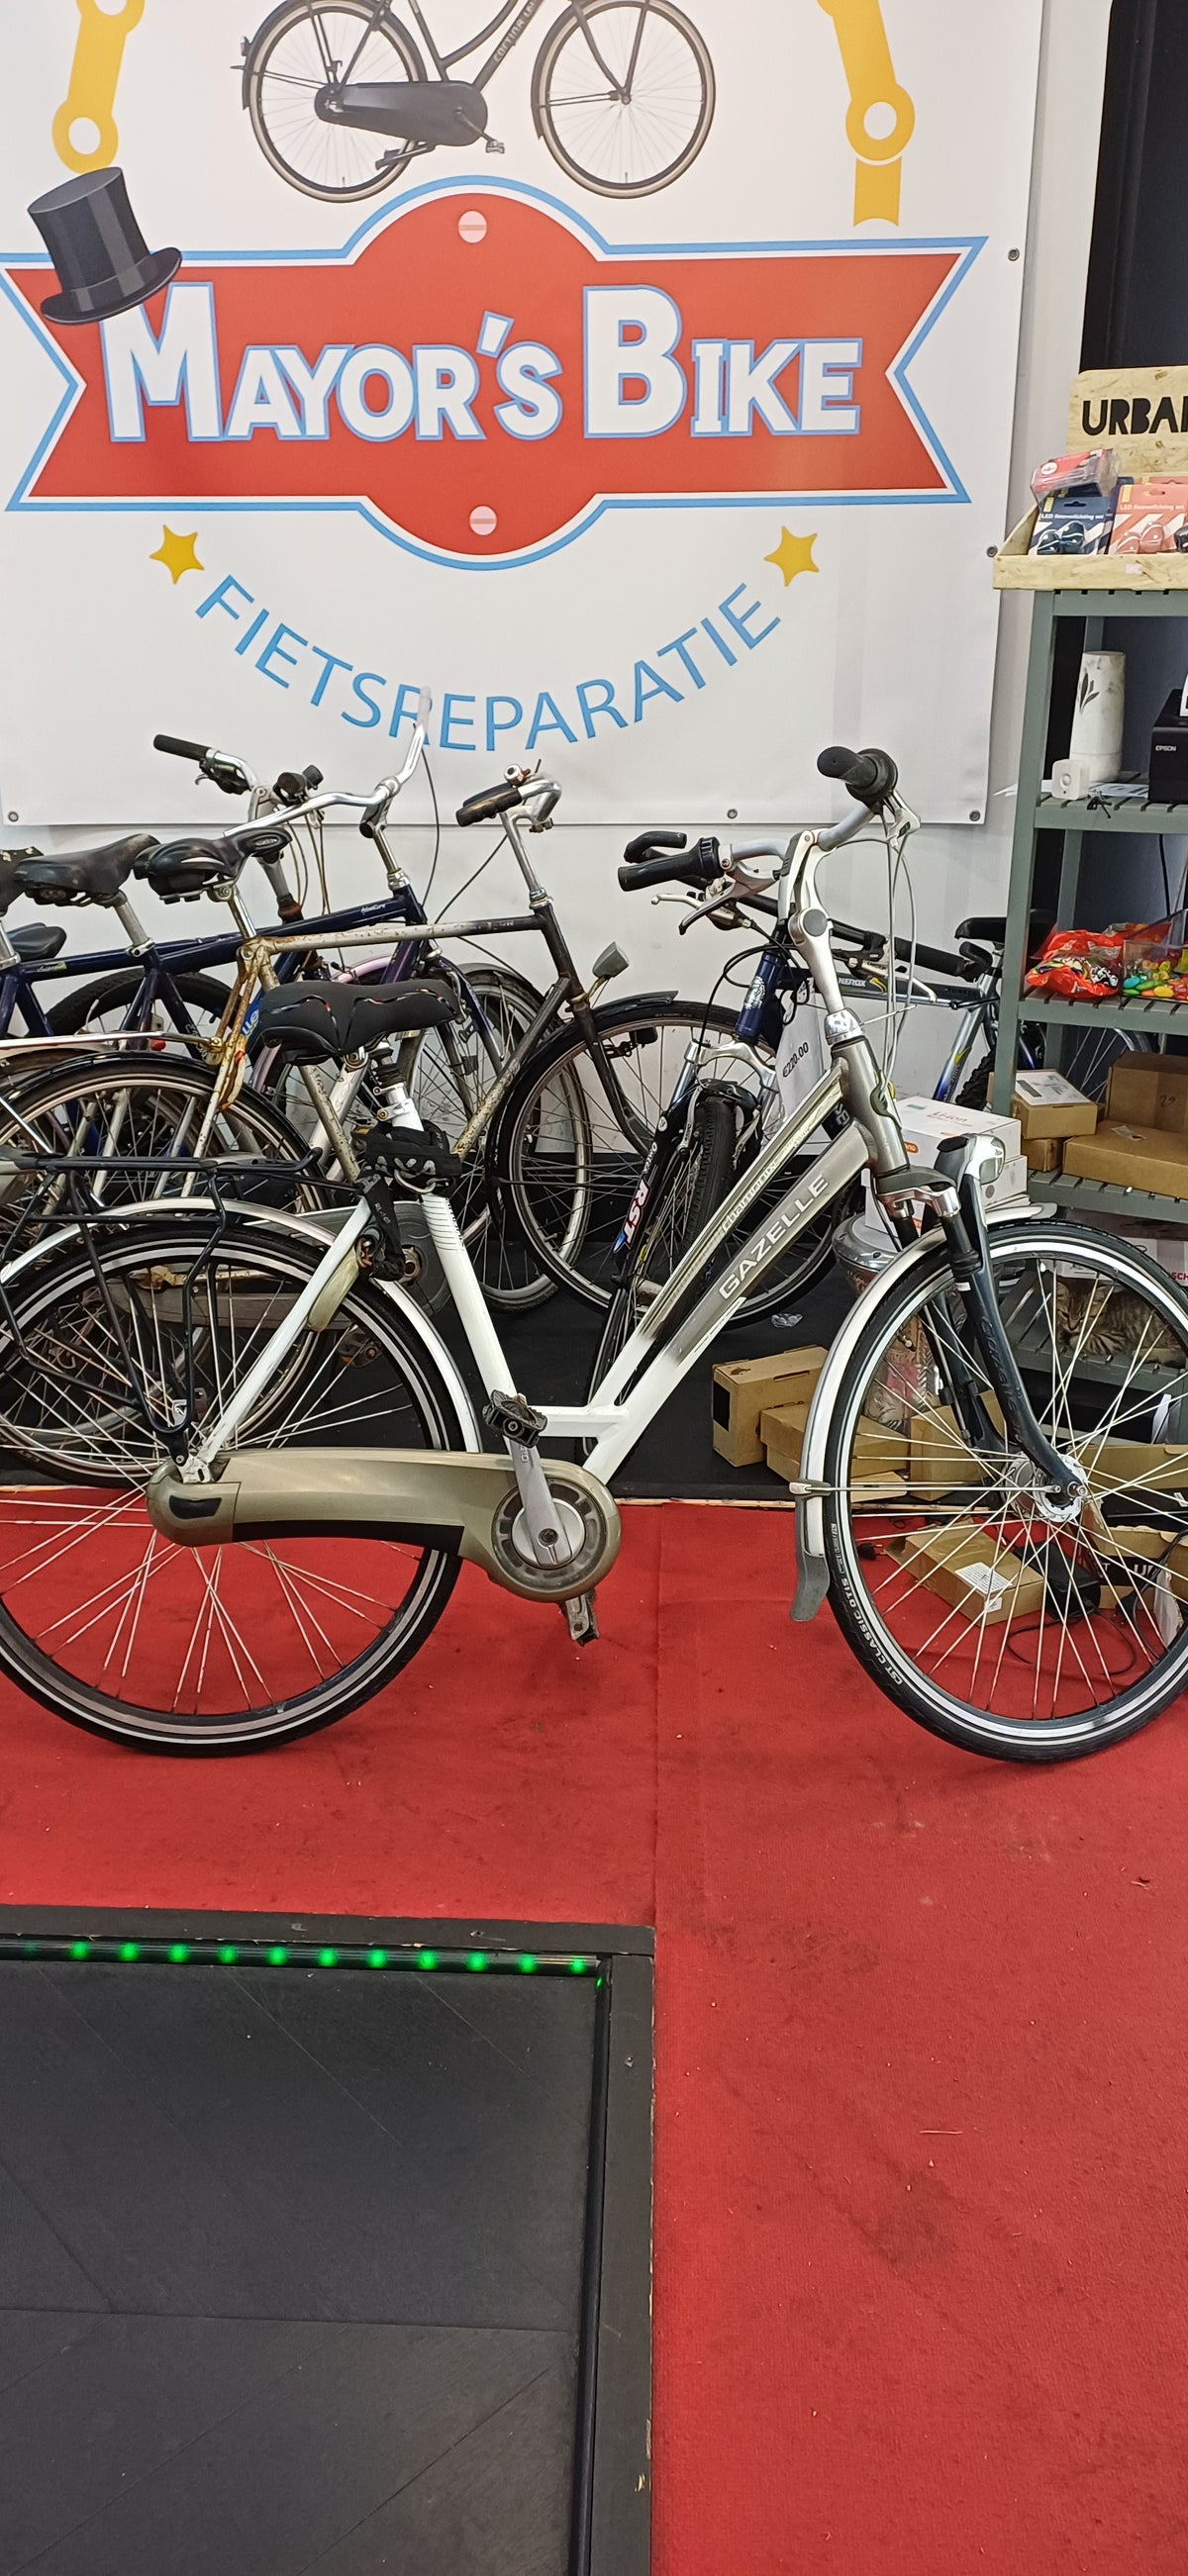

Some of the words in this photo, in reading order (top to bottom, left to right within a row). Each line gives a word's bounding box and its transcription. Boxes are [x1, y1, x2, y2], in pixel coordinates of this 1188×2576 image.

[100, 281, 563, 442] MAYOR'S
[583, 284, 863, 438] BIKE
[1081, 396, 1188, 436] URBA
[195, 575, 781, 752] FIETSREPARATIE
[624, 1178, 649, 1244] RST
[718, 1174, 829, 1299] GAZELLE
[1171, 1272, 1188, 1281] SCH
[842, 1577, 856, 1609] OTIS
[853, 1610, 887, 1666] CLASSIC
[885, 1668, 903, 1685] CST
